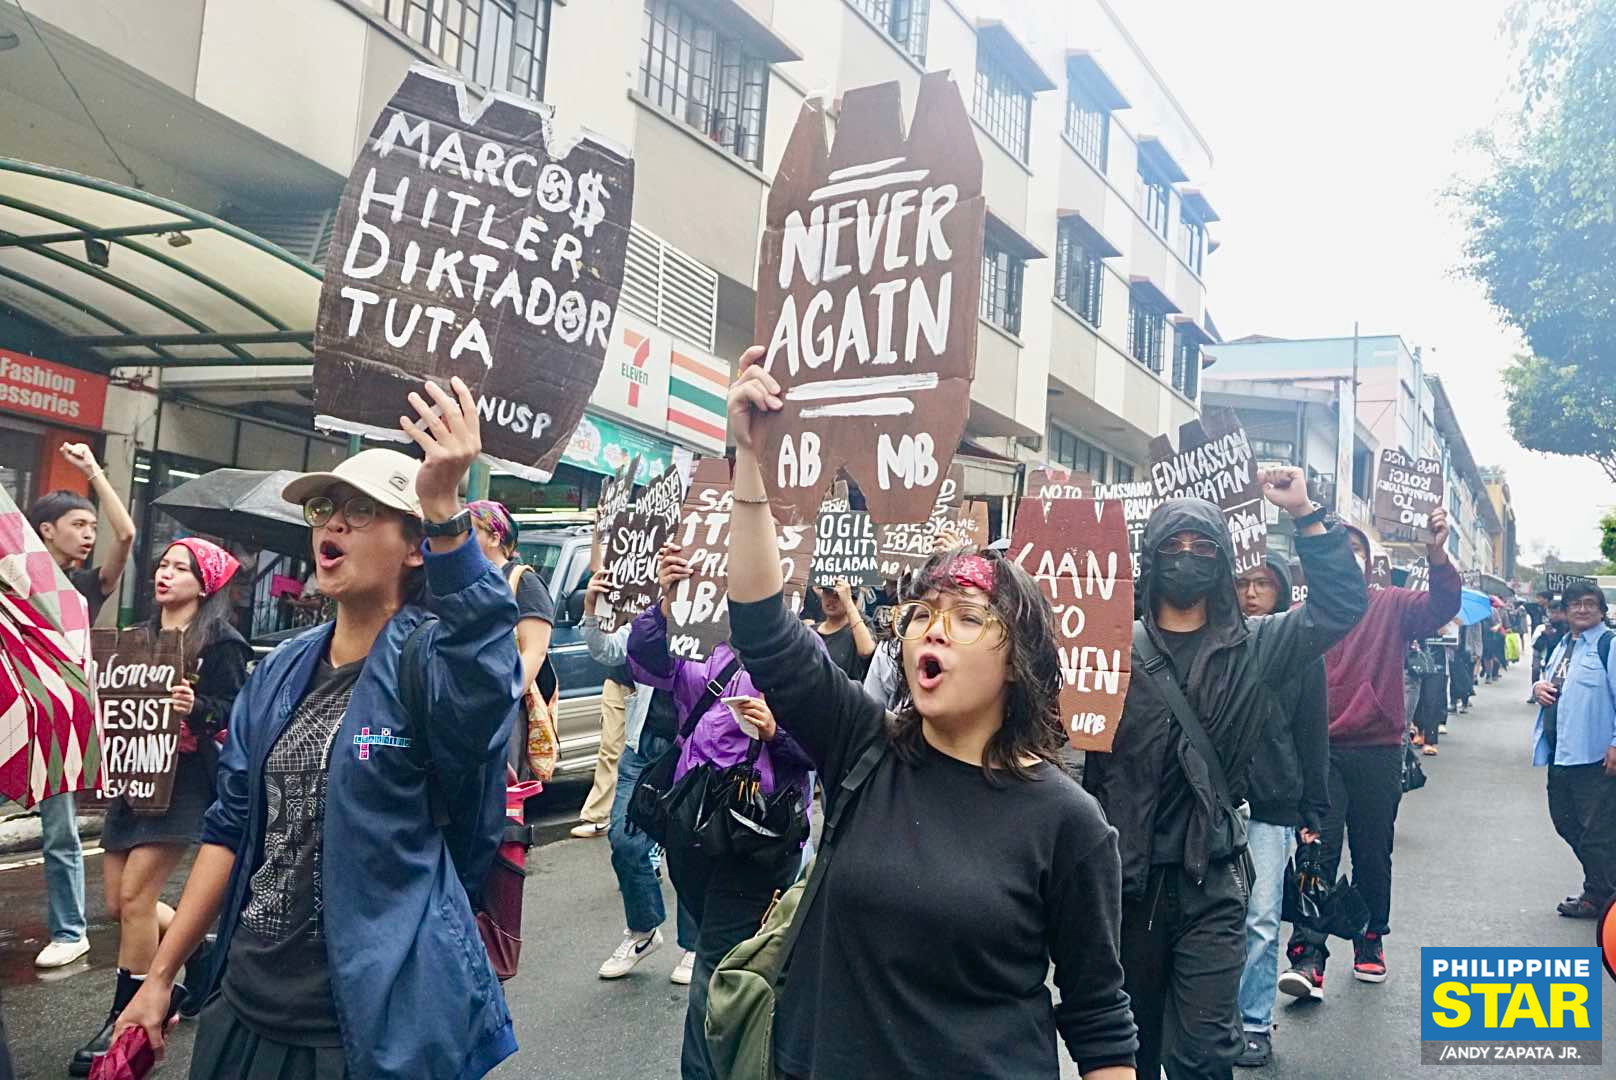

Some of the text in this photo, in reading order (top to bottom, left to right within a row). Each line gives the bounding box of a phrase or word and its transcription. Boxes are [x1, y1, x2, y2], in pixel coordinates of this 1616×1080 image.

[360, 168, 582, 280] HITLER
[778, 183, 959, 289] NEVER
[343, 220, 611, 349] DIKTADOR
[341, 286, 493, 369] TUTA
[763, 271, 953, 377] AGAIN
[0, 357, 76, 395] Fashion
[476, 394, 553, 440] NUSP
[777, 431, 939, 490] AB MB
[1039, 484, 1083, 499] NO TO
[1151, 427, 1253, 496] EDUKASYON
[103, 698, 175, 731] ESIST
[1070, 712, 1106, 736] UPB
